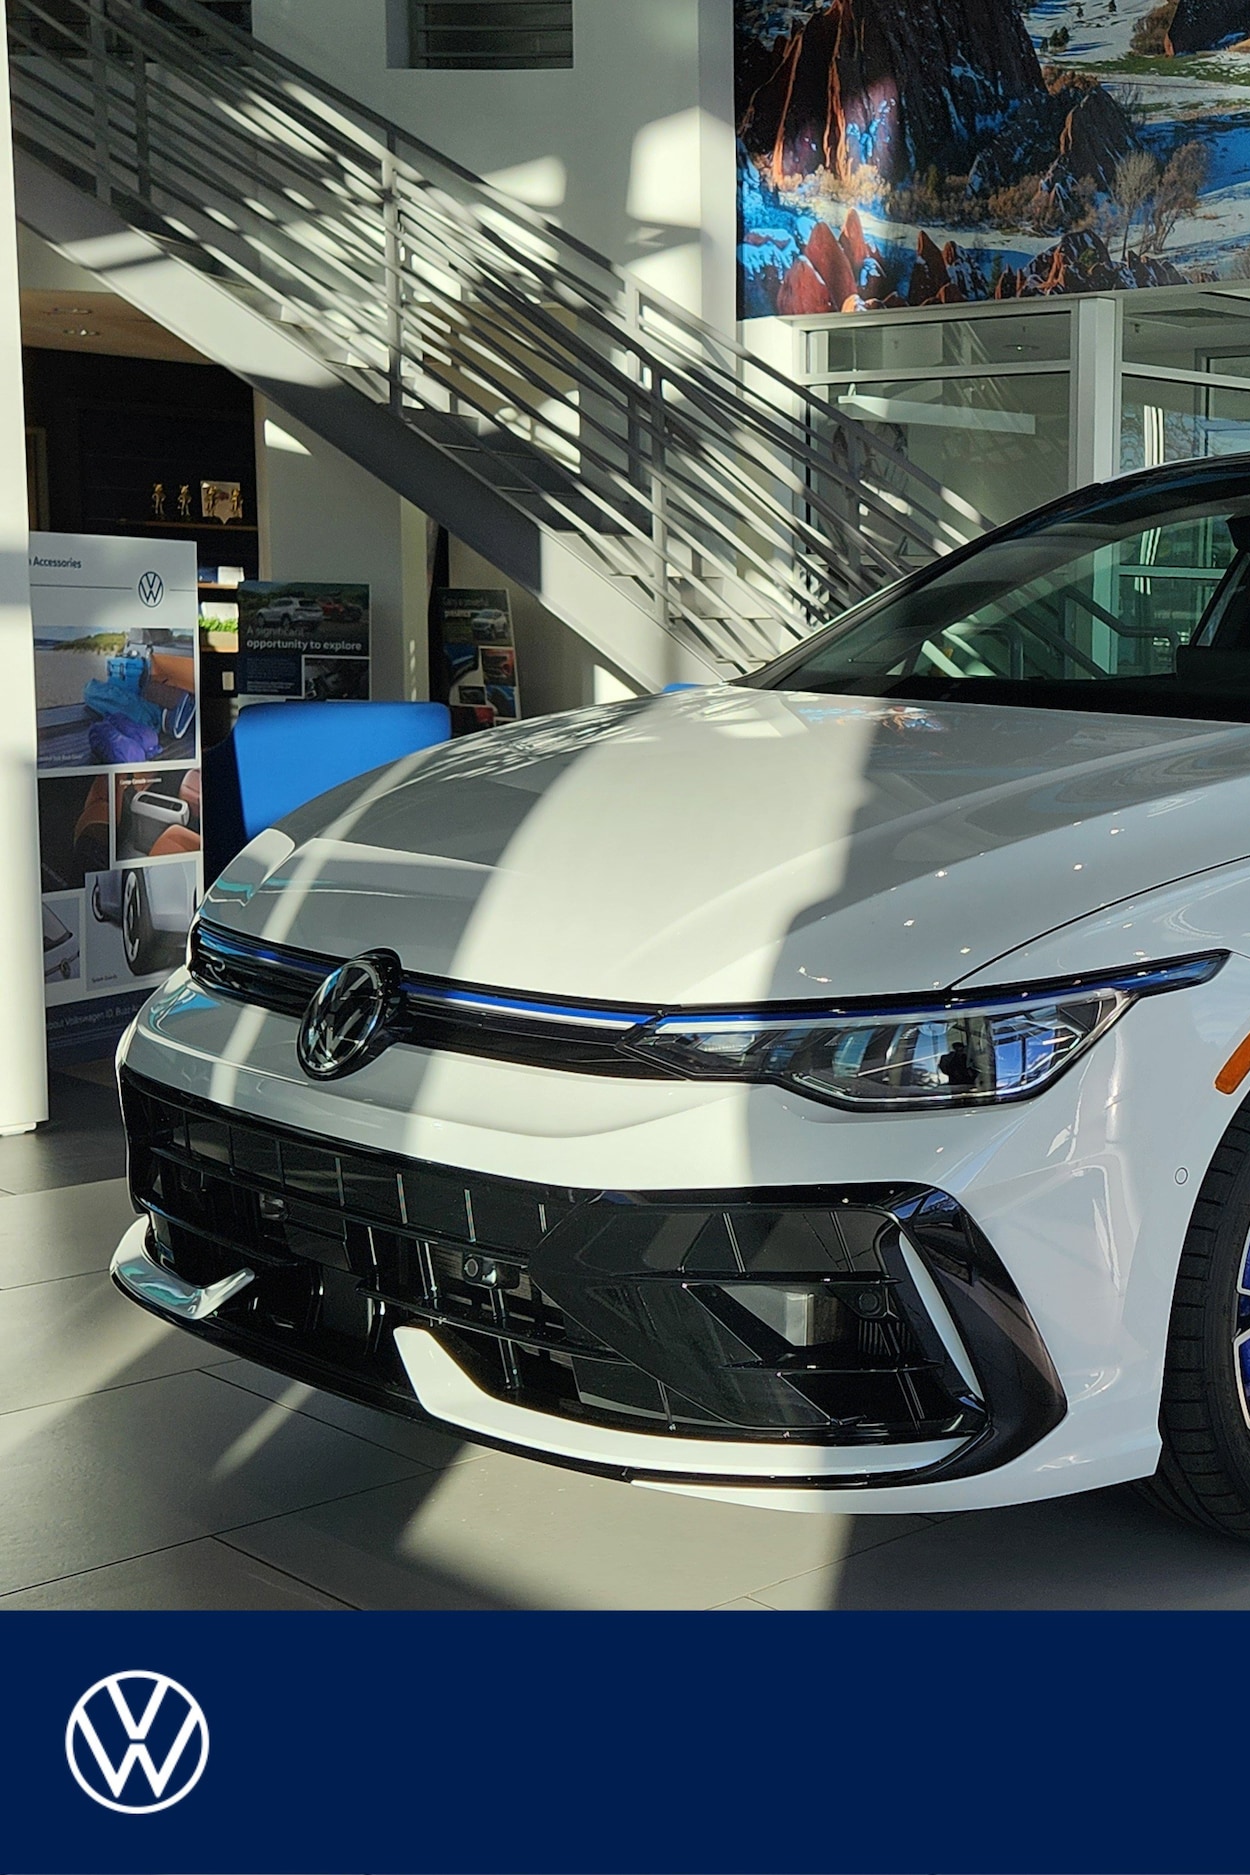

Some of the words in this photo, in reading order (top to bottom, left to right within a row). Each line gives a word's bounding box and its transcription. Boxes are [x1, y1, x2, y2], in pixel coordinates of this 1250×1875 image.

[33, 555, 82, 569] Accessories
[246, 639, 308, 651] opportunity
[310, 640, 321, 650] to
[323, 640, 362, 652] explore
